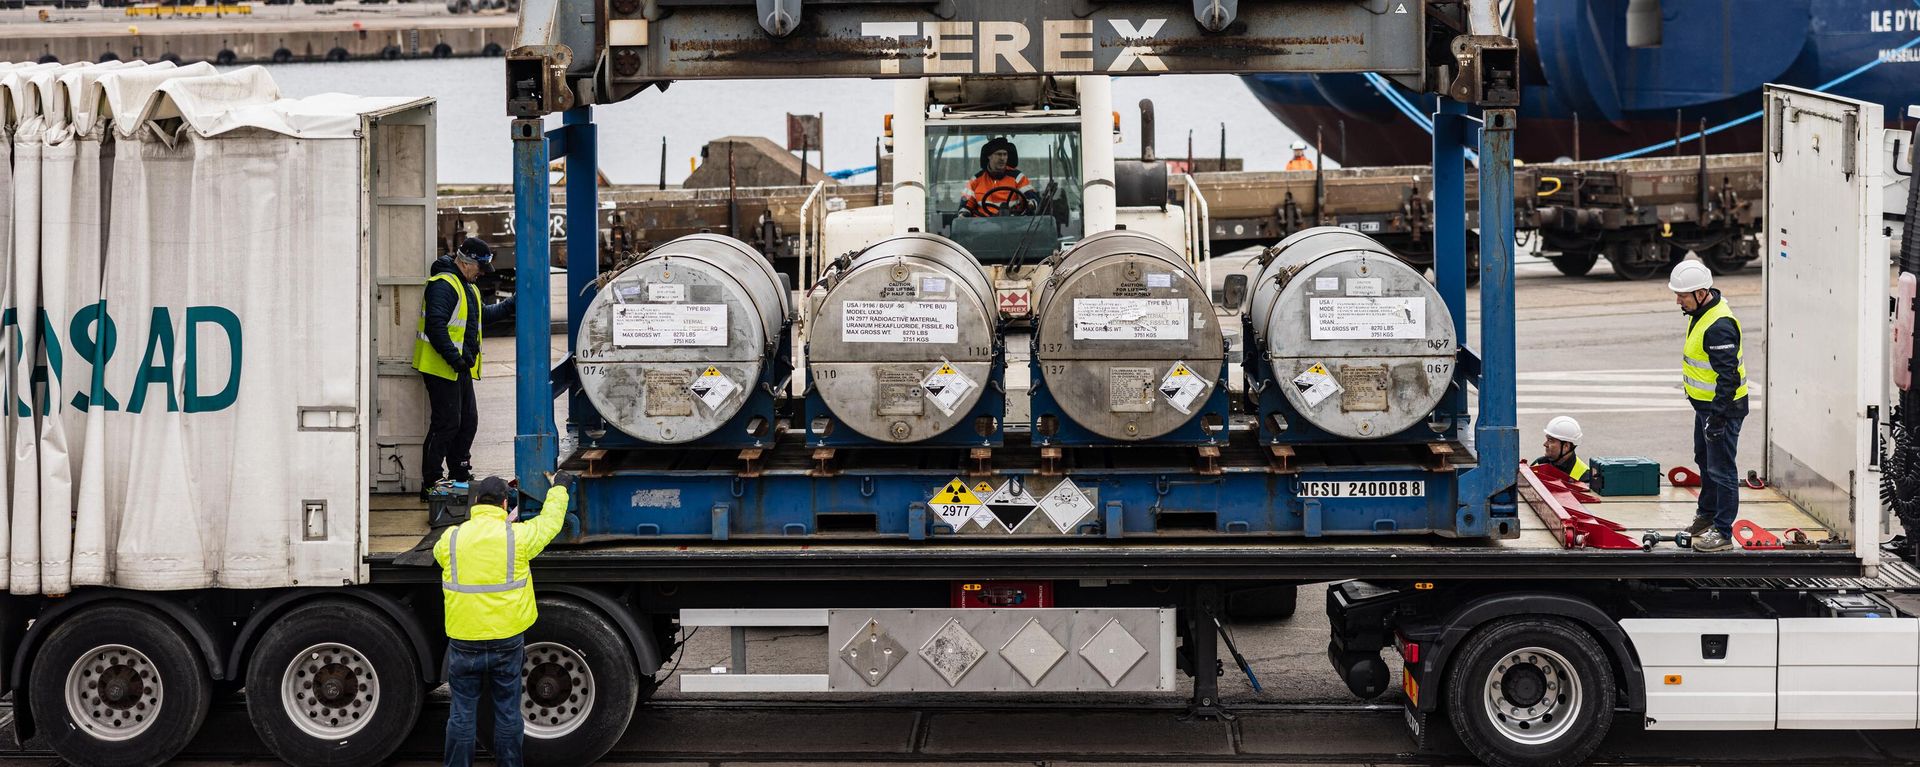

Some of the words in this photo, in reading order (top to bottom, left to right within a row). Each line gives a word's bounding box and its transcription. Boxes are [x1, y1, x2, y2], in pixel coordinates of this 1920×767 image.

[1871, 10, 1892, 32] ILE
[861, 18, 1169, 74] TEREX
[968, 346, 989, 356] 110
[1042, 343, 1063, 353] 137
[816, 369, 837, 380] 110
[1045, 365, 1065, 375] 137
[1427, 364, 1449, 374] 067
[1300, 482, 1340, 496] NCSU
[942, 505, 970, 517] 2977
